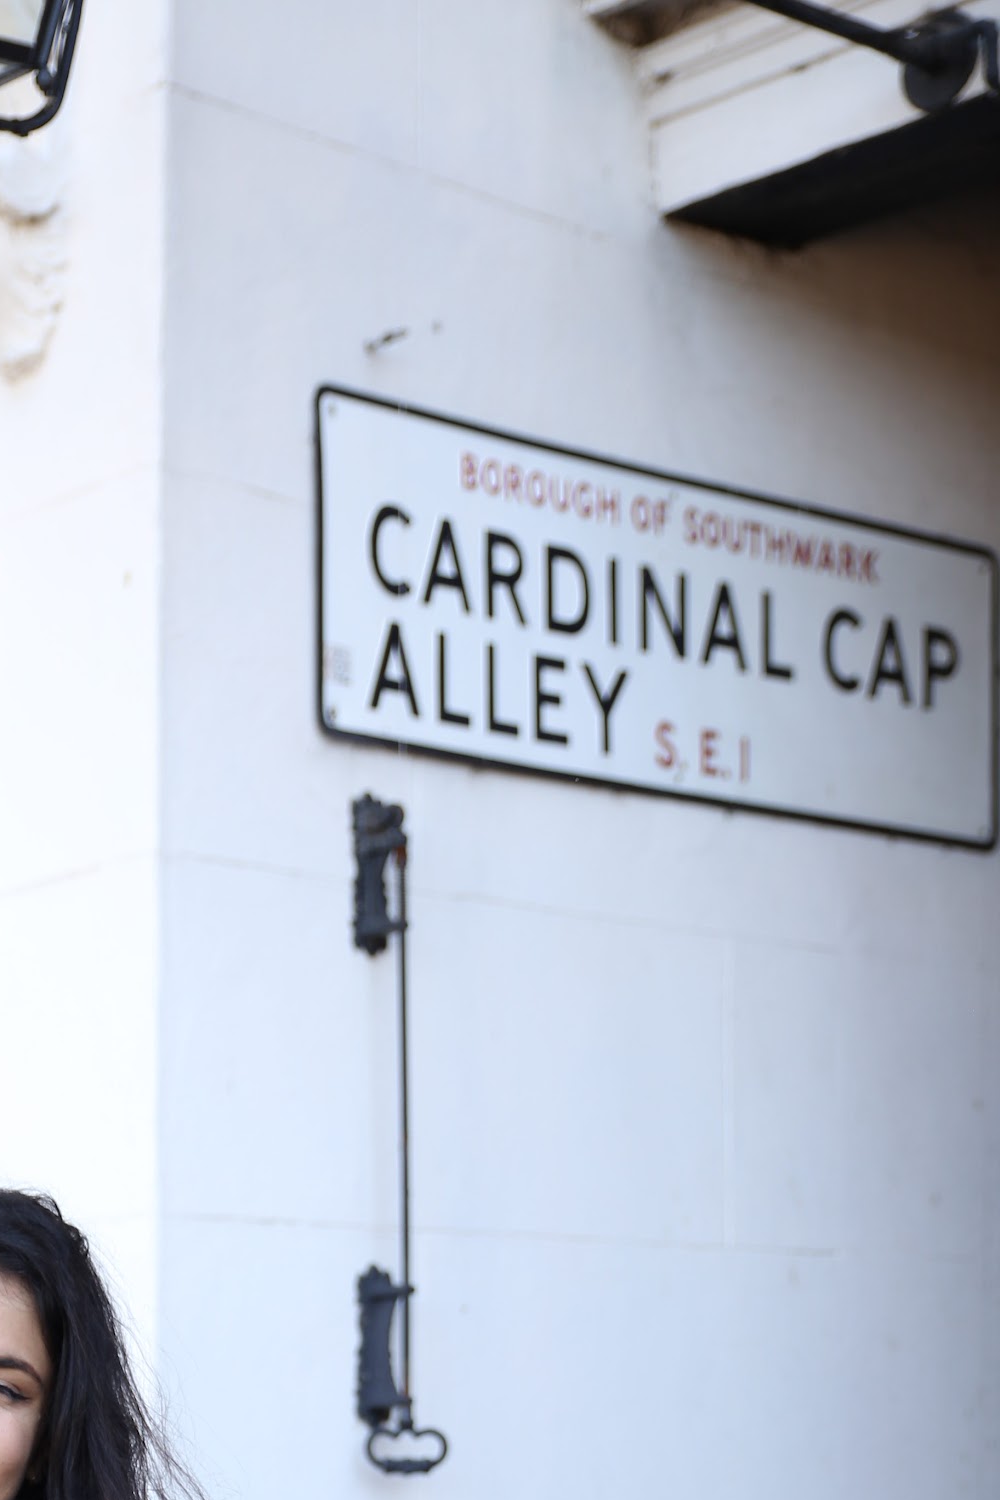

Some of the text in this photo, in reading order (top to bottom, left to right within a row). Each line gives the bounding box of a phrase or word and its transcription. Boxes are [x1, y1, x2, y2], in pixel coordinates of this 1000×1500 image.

[459, 451, 880, 583] BOROUGH OF SOUTHWARK
[368, 505, 961, 708] CARDINAL CAP
[368, 622, 628, 754] ALLEY
